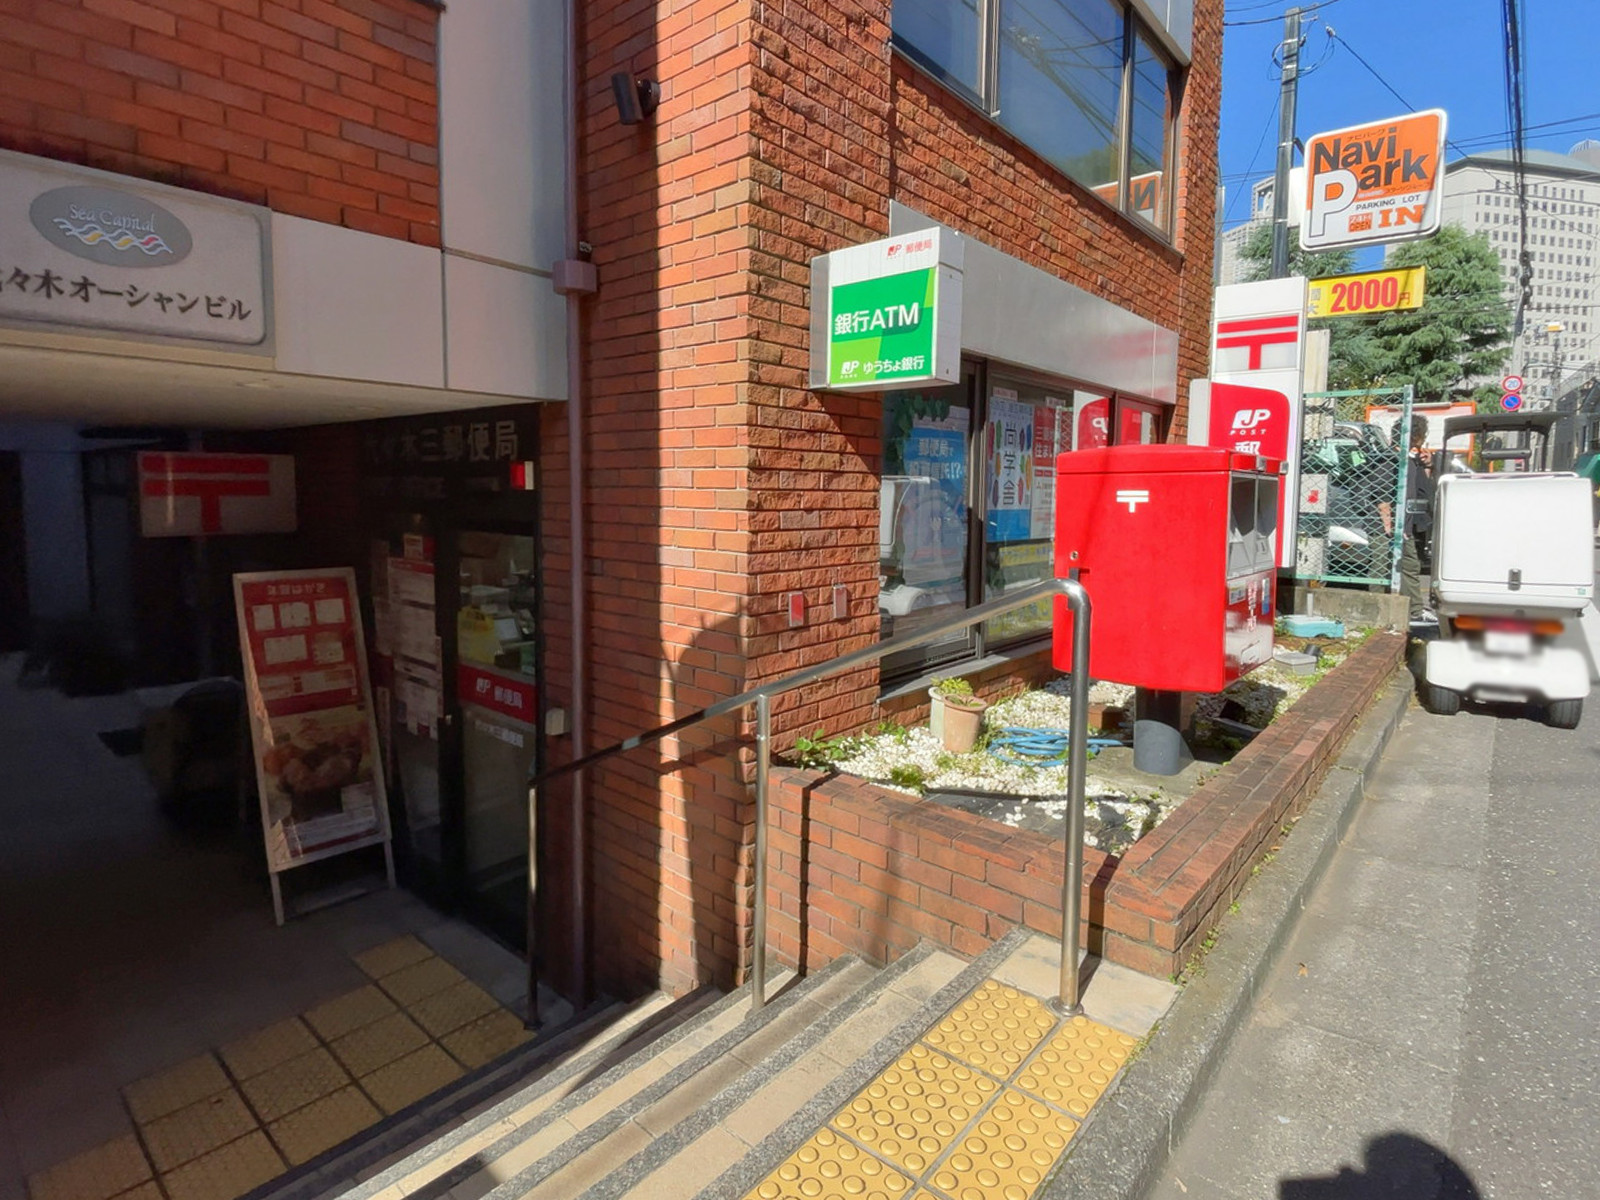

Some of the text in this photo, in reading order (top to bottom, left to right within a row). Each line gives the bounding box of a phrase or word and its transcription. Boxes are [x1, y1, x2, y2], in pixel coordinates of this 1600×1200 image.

[1314, 127, 1397, 174] Navi
[1309, 149, 1429, 238] Park
[1356, 194, 1421, 211] PARKING LOT
[70, 204, 156, 233] Sea Capital
[1349, 220, 1372, 231] OPEN
[1378, 204, 1425, 229] IN
[0, 266, 252, 321] 々木オーシャンビル
[834, 302, 919, 335] 銀行ATM
[863, 355, 925, 374] ゆうちょ銀行
[1507, 379, 1519, 388] 20
[1232, 409, 1271, 429] JP
[1229, 428, 1267, 436] POST
